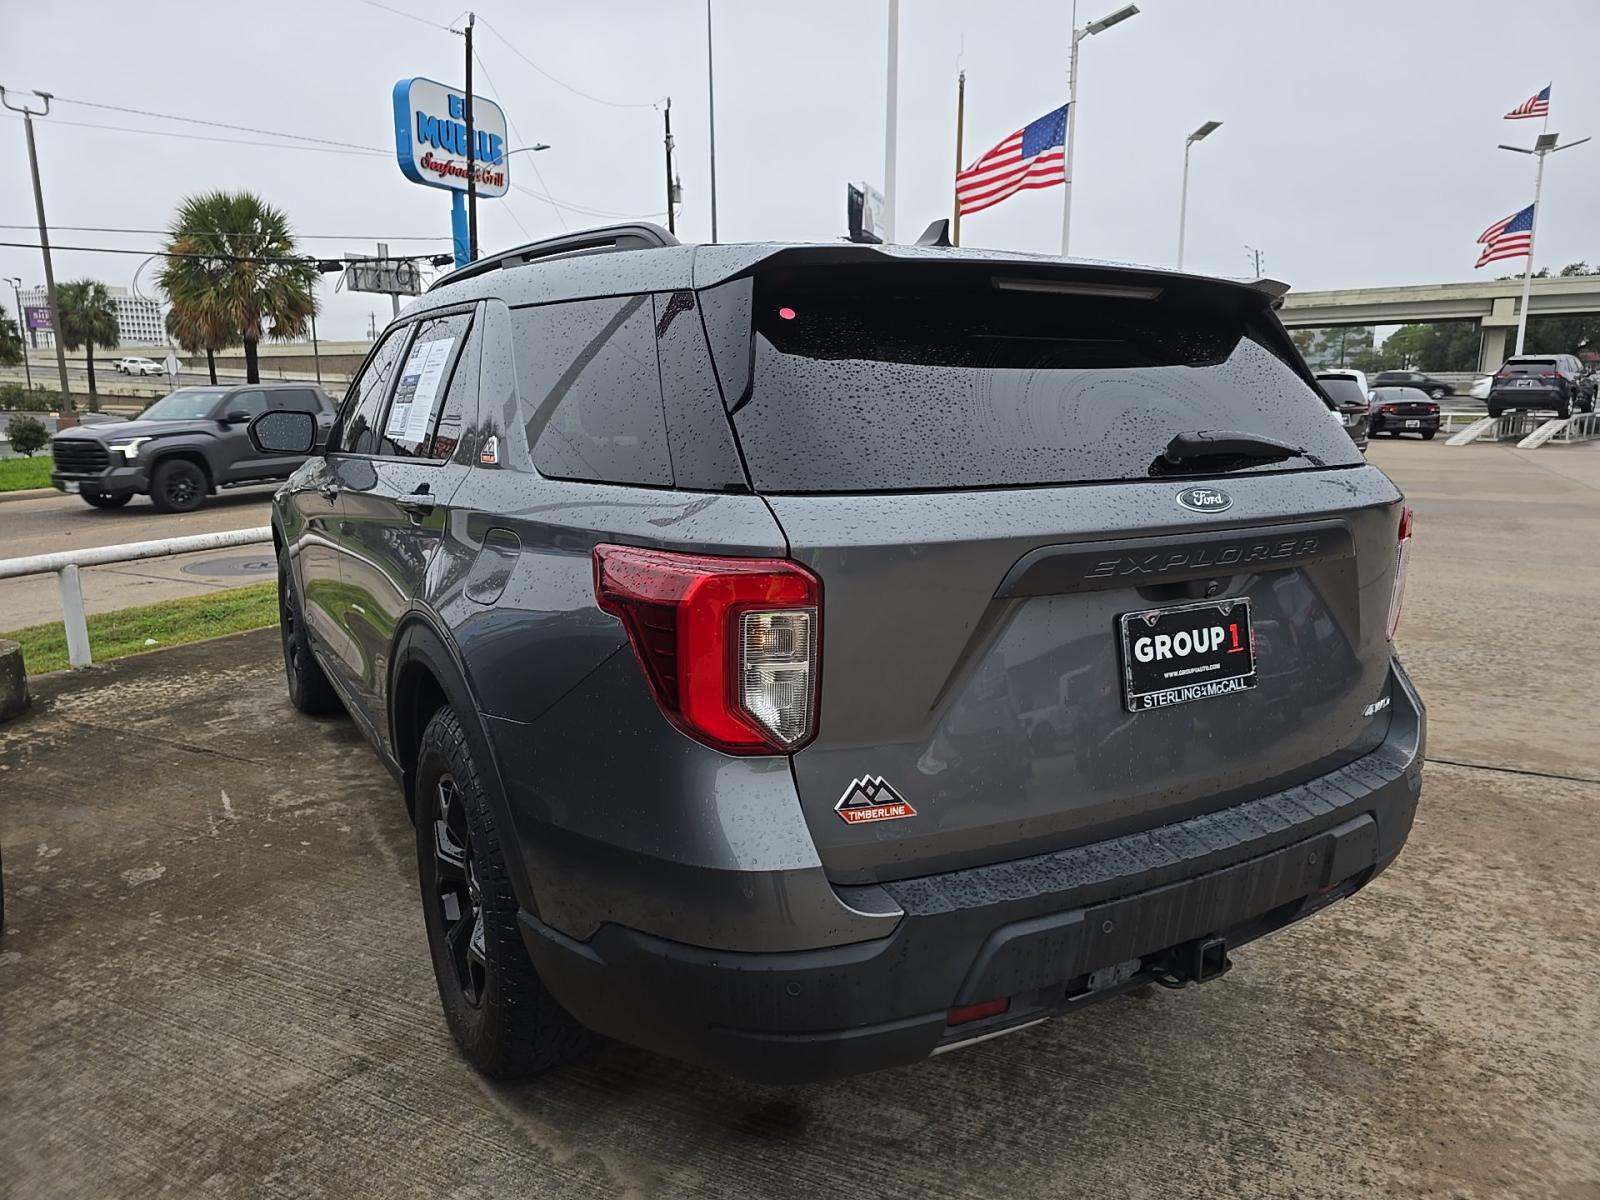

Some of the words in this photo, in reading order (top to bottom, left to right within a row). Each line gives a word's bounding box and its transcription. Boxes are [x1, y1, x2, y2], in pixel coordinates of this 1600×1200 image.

[1193, 490, 1224, 506] Ford
[1084, 536, 1320, 579] EXPLORER
[1134, 626, 1225, 663] GROUP
[1227, 623, 1244, 653] 1
[1143, 685, 1201, 708] STERLING
[1207, 677, 1248, 696] McCALL
[848, 806, 906, 821] TIMBERLINE
